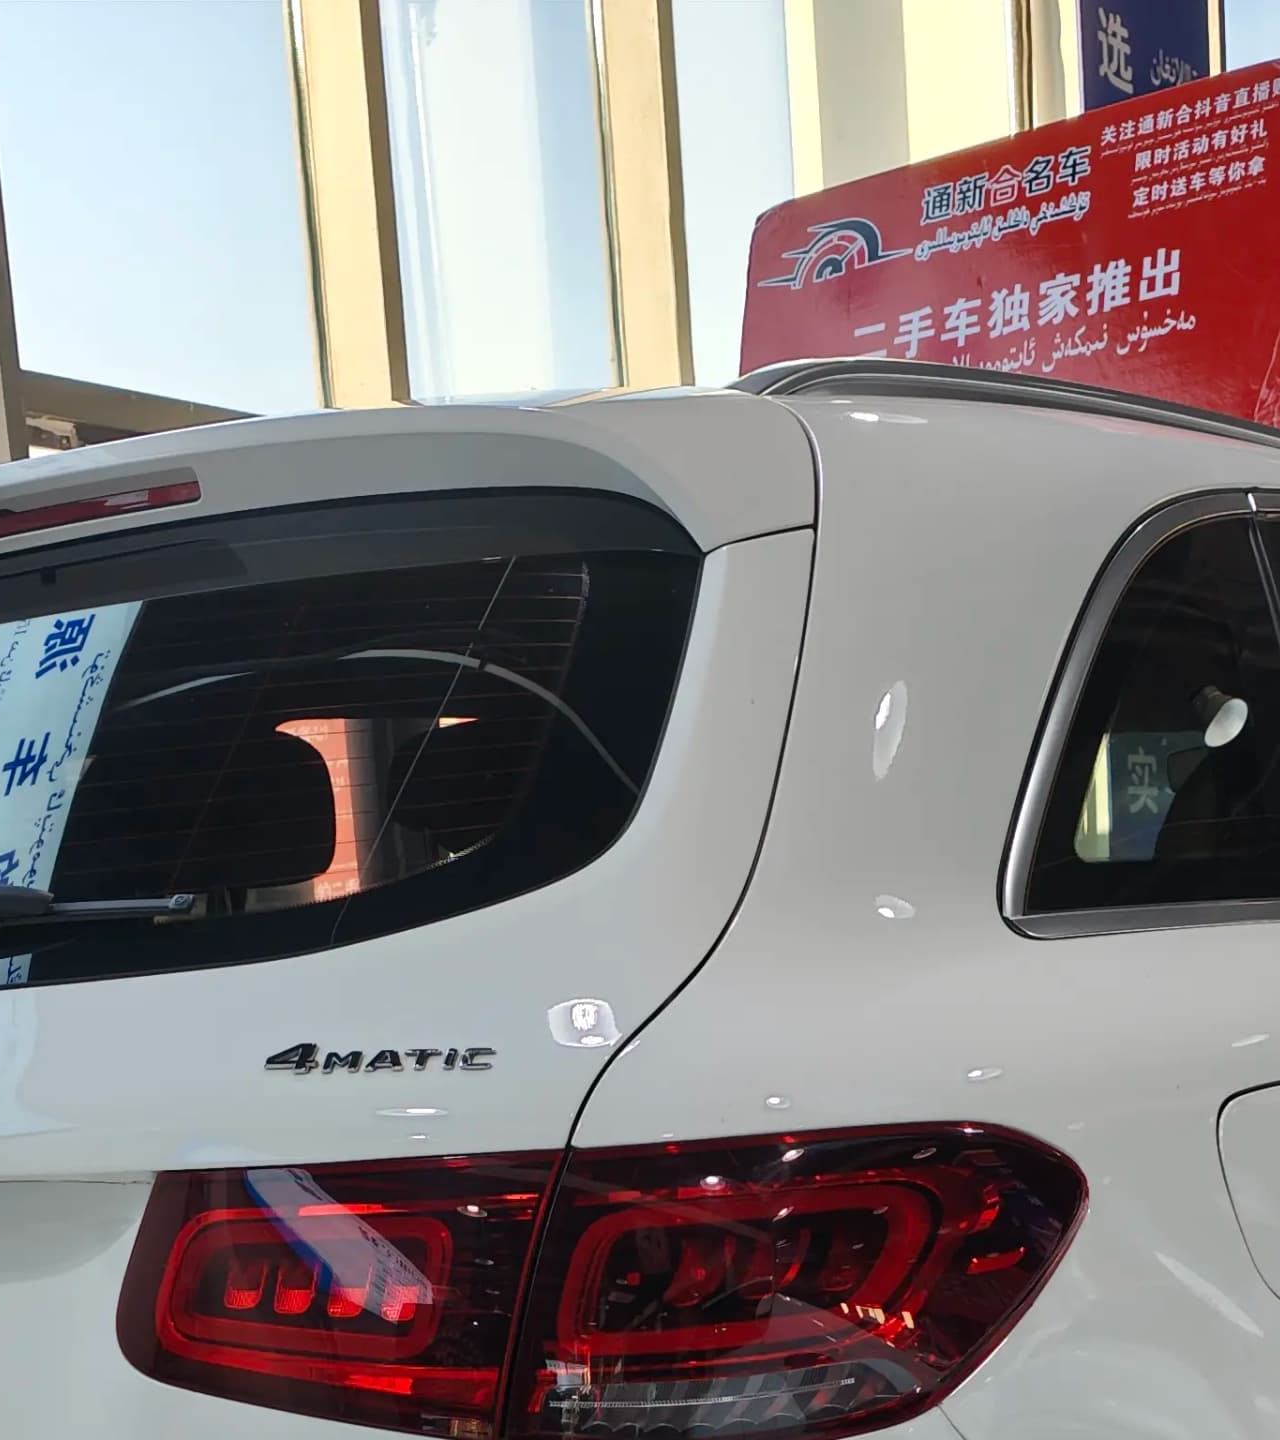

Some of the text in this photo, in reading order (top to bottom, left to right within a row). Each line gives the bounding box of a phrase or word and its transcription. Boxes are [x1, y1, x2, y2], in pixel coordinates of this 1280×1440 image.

[1097, 7, 1134, 95] 选
[1134, 118, 1268, 172] 限时活动有好礼
[920, 145, 1092, 226] 通新合名车
[1131, 155, 1266, 208] 定时送车等你拿
[853, 247, 1181, 360] 二手车独家推出
[264, 1042, 497, 1074] 4MATIC
